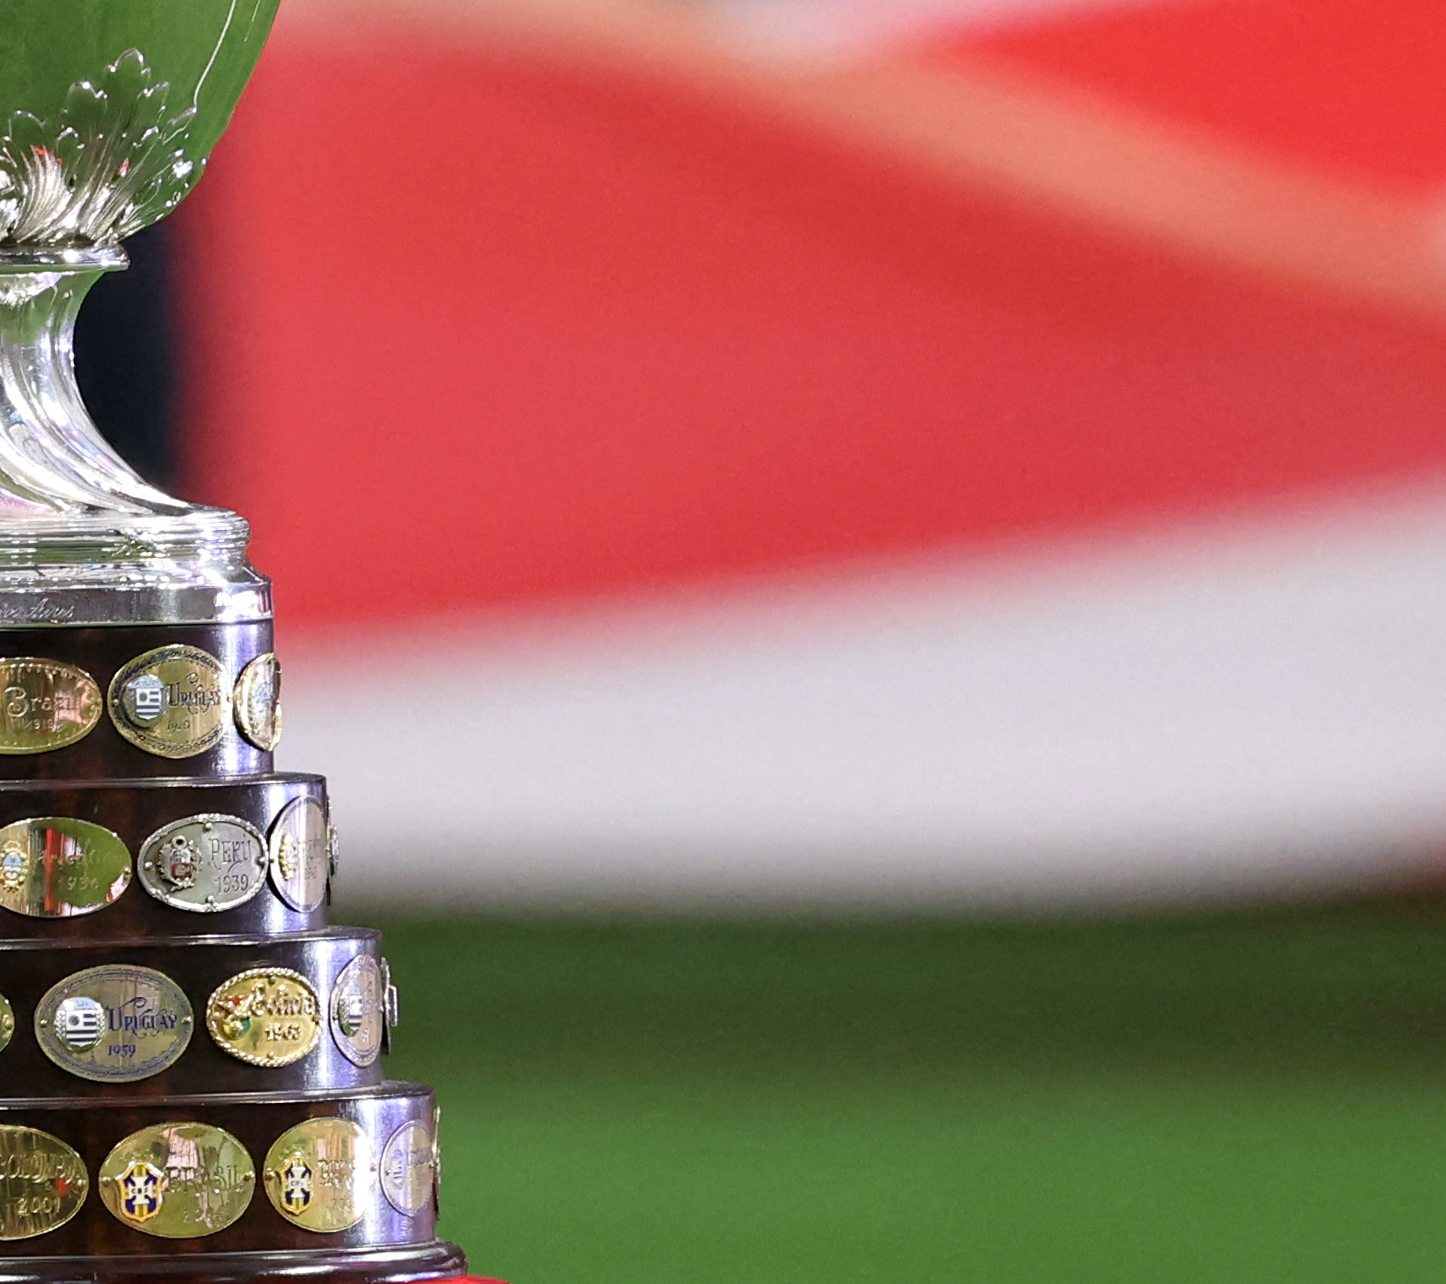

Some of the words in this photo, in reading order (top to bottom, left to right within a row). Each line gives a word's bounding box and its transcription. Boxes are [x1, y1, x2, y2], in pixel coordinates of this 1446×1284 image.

[214, 873, 250, 894] 1939
[106, 996, 178, 1039] URUGUAY
[108, 1044, 136, 1058] 1959
